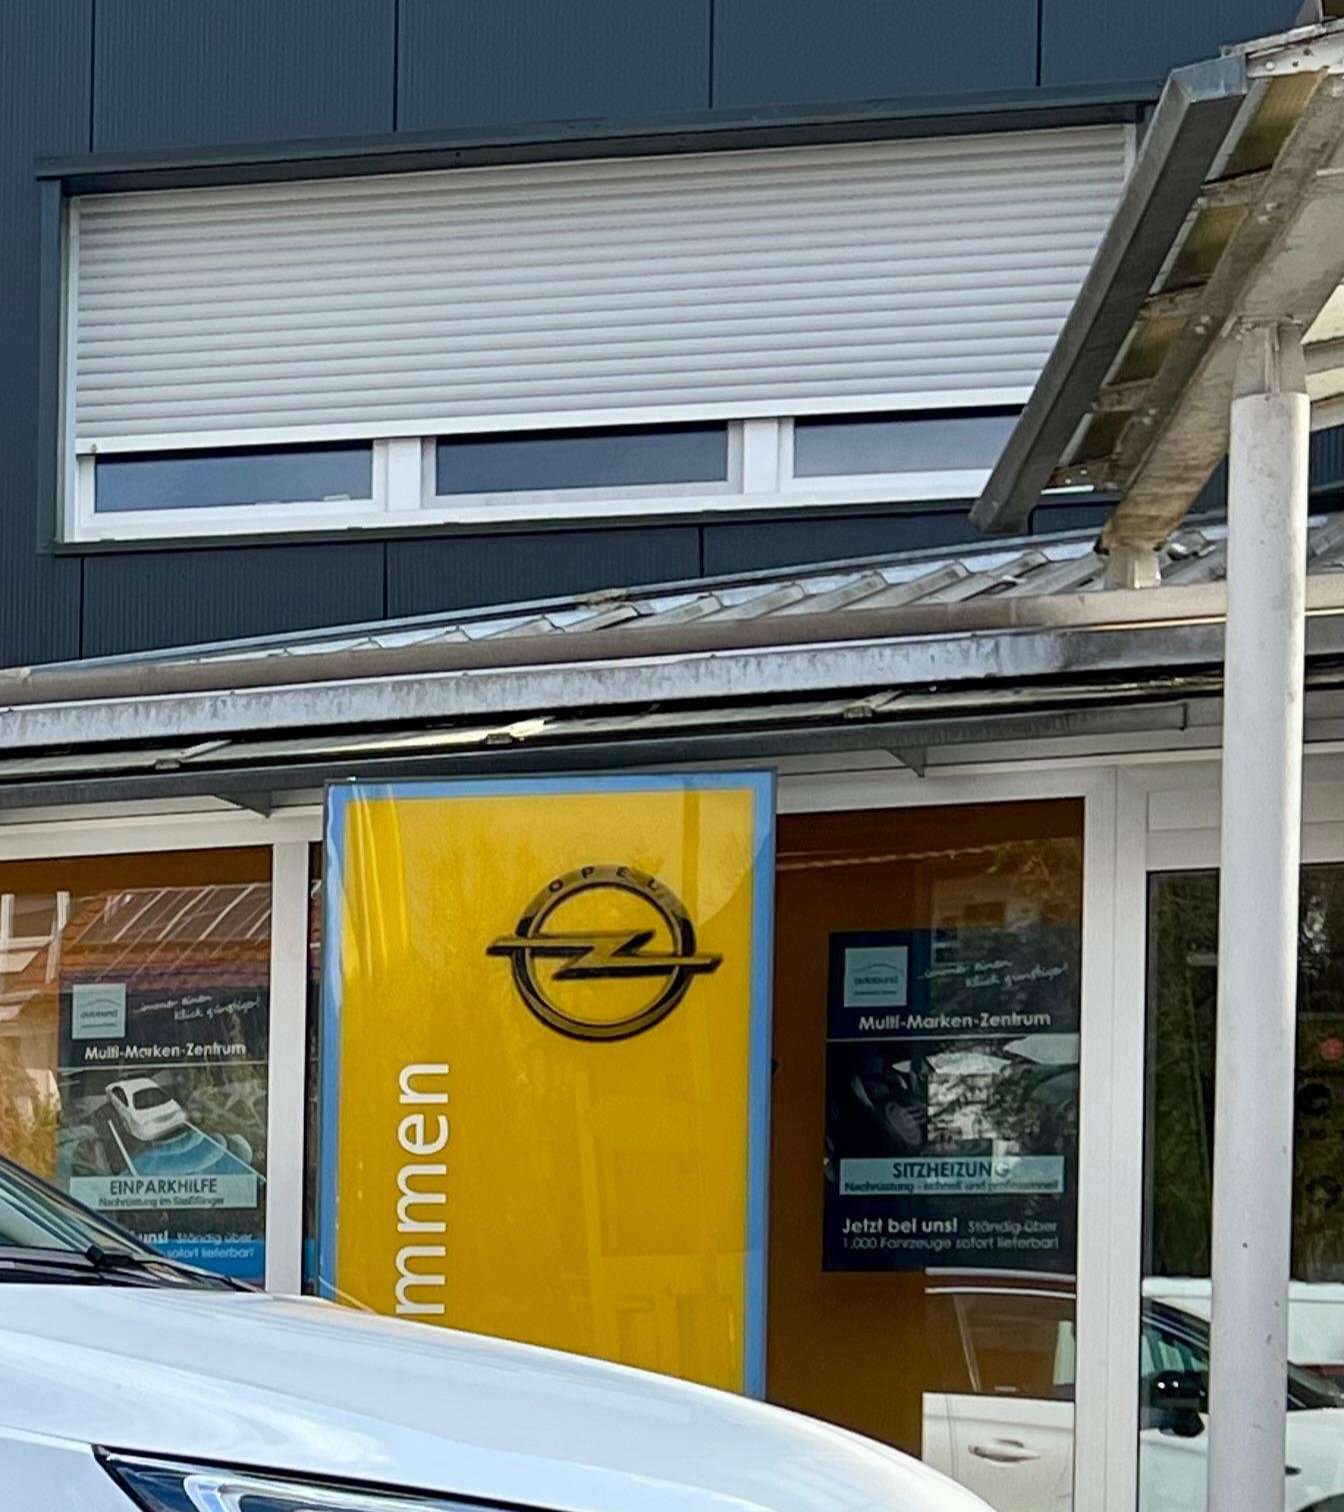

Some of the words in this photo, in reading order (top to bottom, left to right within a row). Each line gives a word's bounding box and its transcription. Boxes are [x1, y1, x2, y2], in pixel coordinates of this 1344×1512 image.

[548, 865, 660, 893] OPEL
[858, 1012, 1051, 1031] Multi-Marken-Zentrum
[84, 1042, 247, 1061] Multi-Marken-Zentrum
[892, 1161, 1011, 1178] SITZHEIZUNG
[109, 1178, 218, 1196] EINPARKHILFE
[395, 1063, 450, 1314] mmen
[842, 1218, 883, 1234] Jetzt
[887, 1217, 917, 1233] bei
[922, 1217, 958, 1233] uns!
[1023, 1219, 1058, 1231] über
[955, 1235, 994, 1249] sofort
